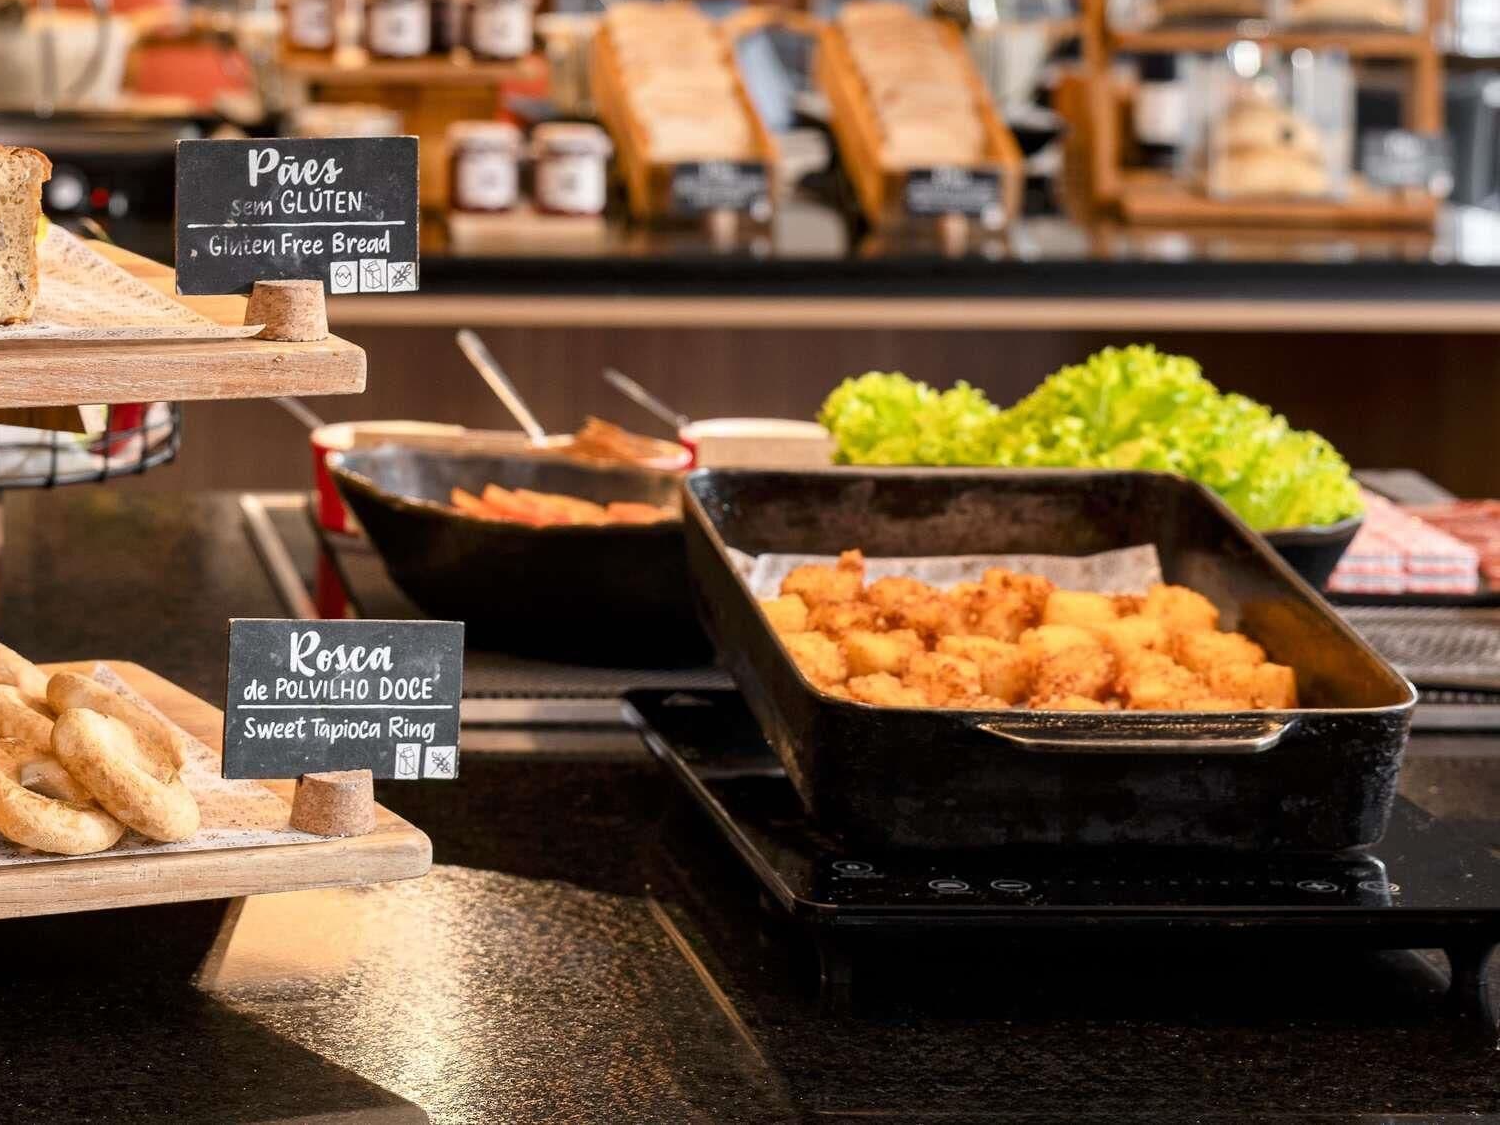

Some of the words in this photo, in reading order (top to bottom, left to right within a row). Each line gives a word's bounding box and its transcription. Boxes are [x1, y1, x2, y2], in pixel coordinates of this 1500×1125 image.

[248, 148, 344, 188] Pães
[230, 198, 274, 218] sem
[280, 188, 362, 215] GLÚTEN
[208, 234, 276, 257] Gluten
[281, 232, 324, 255] Free
[332, 229, 391, 254] Bread
[289, 630, 394, 676] Rosca
[243, 679, 268, 701] de
[275, 677, 369, 701] POLVILHO
[379, 676, 433, 700] DOCE
[243, 715, 307, 741] Sweet
[311, 716, 381, 745] Tapioca
[388, 715, 435, 743] Ring
